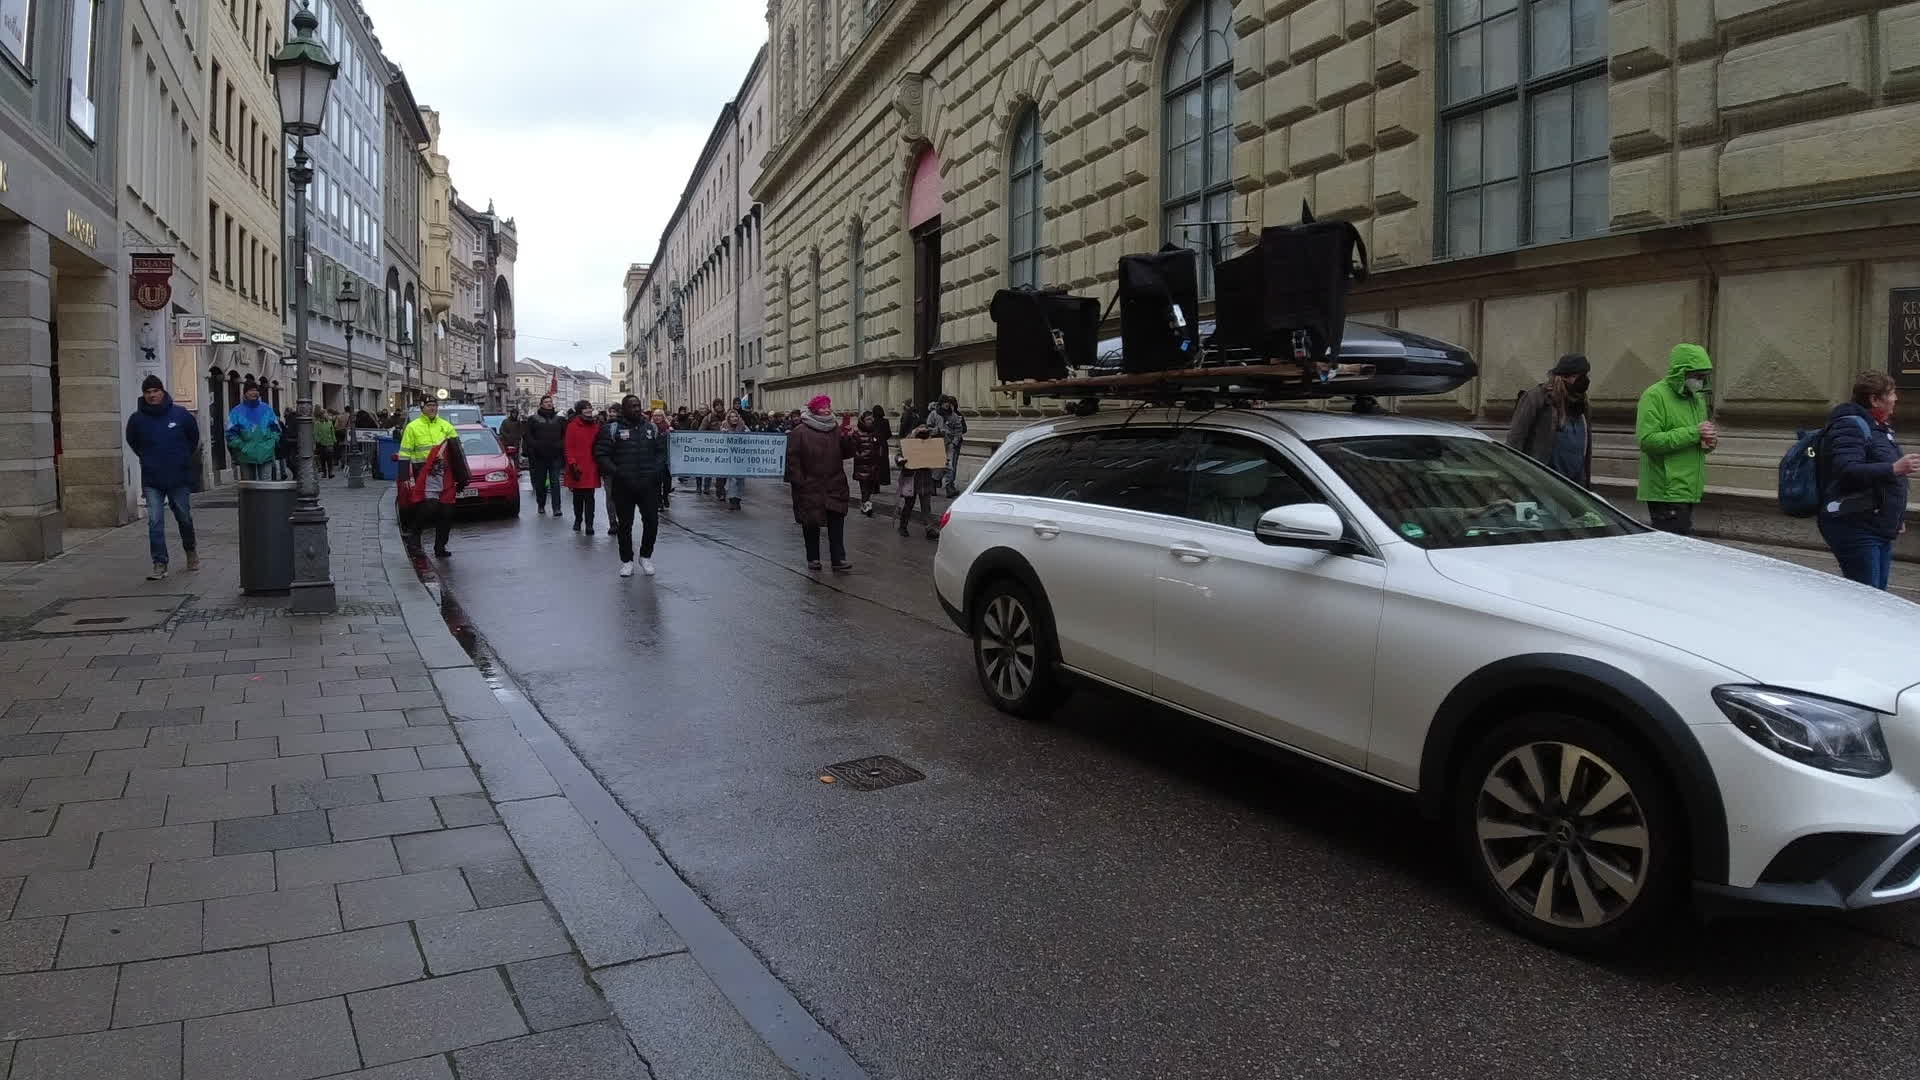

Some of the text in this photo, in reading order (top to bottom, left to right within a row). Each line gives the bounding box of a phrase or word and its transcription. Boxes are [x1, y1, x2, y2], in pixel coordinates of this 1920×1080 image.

[727, 436, 769, 445] Maßeinheit
[772, 438, 785, 446] der
[684, 446, 775, 455] Dimension Widerstand
[714, 456, 732, 464] Karl
[734, 456, 745, 464] für
[748, 456, 760, 464] 100
